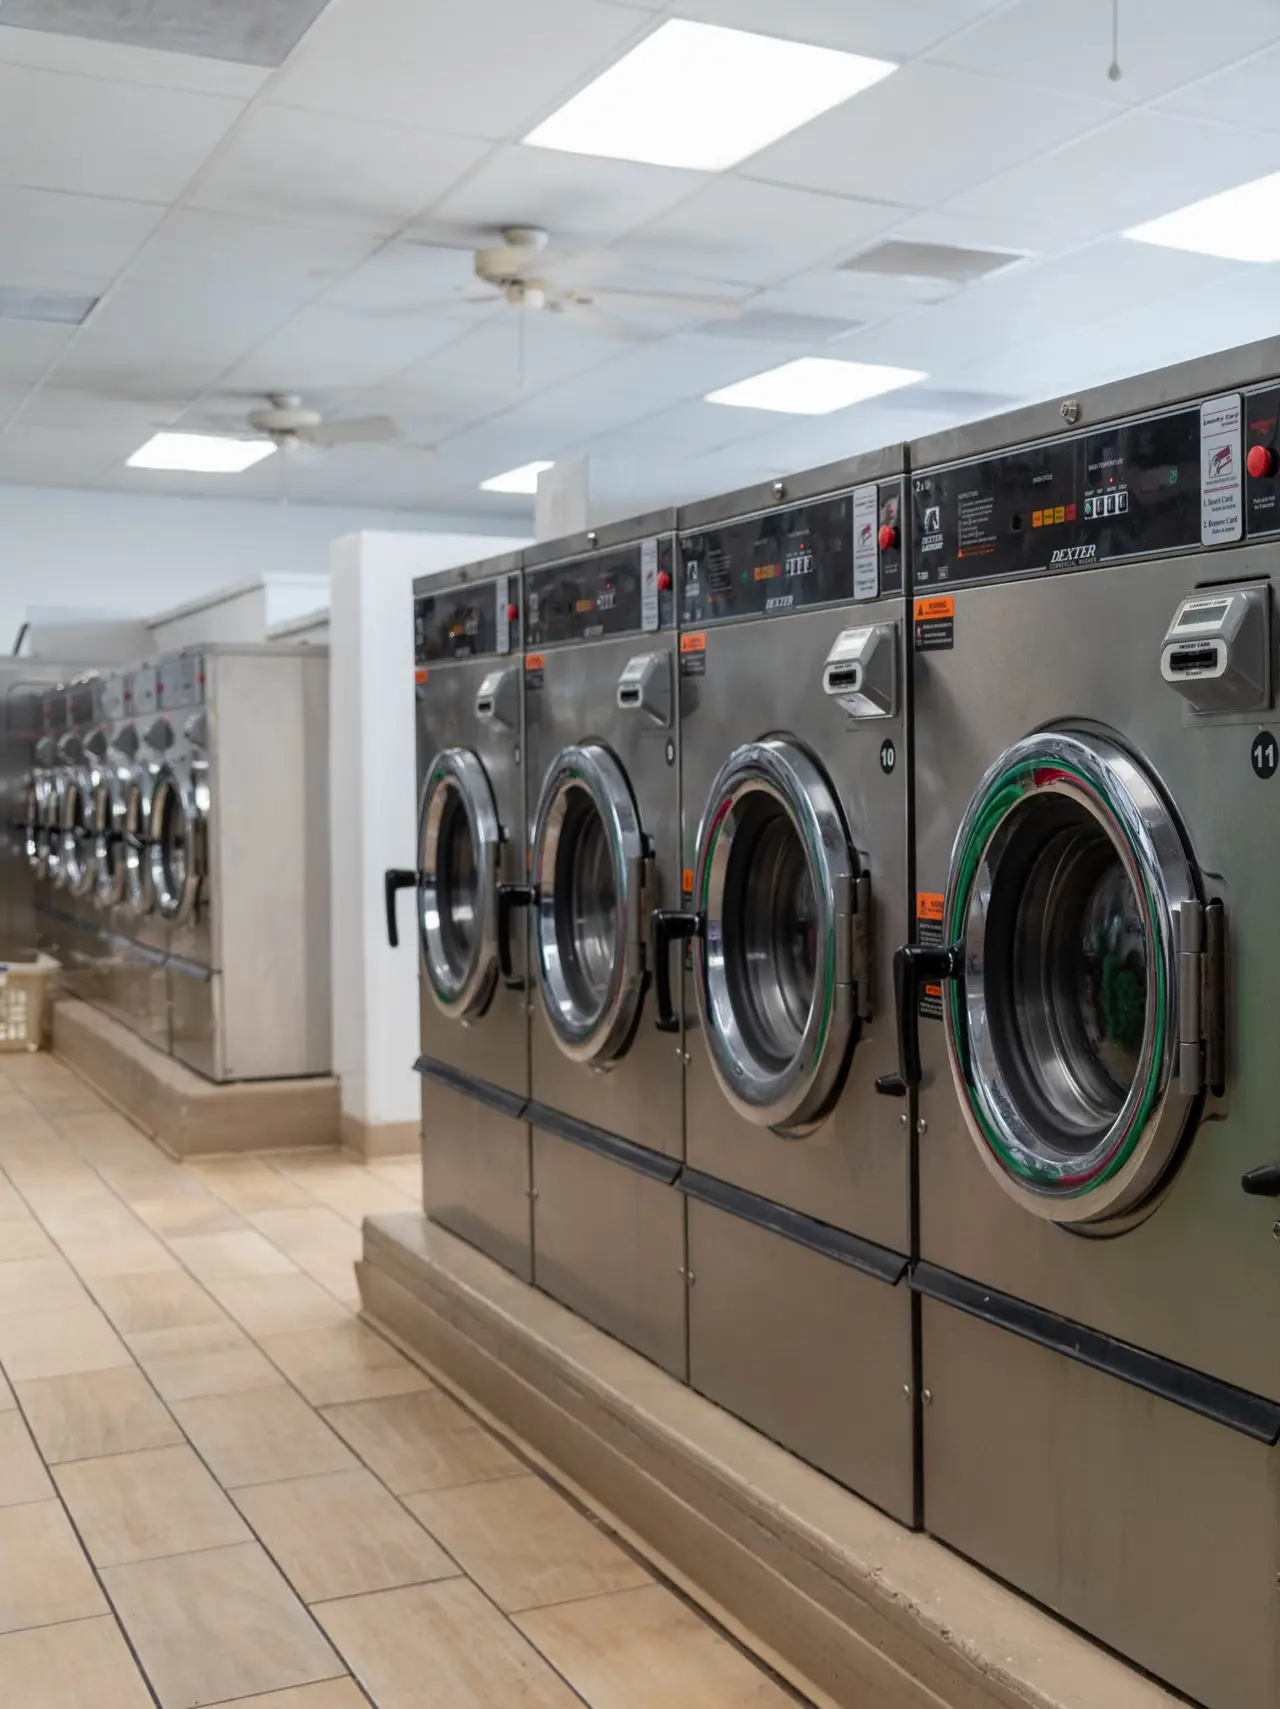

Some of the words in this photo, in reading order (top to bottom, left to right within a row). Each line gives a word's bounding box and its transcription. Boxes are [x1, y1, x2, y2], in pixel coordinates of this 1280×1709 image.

[1204, 414, 1224, 426] Laundry
[1225, 411, 1239, 420] Card
[1208, 497, 1221, 507] Insert
[1222, 495, 1233, 505] Card
[1208, 518, 1226, 529] Remove
[1227, 516, 1238, 525] Card
[1051, 545, 1096, 563] DEXTER
[765, 595, 793, 609] DEXTER
[881, 749, 894, 766] 10
[1254, 744, 1274, 768] 11
